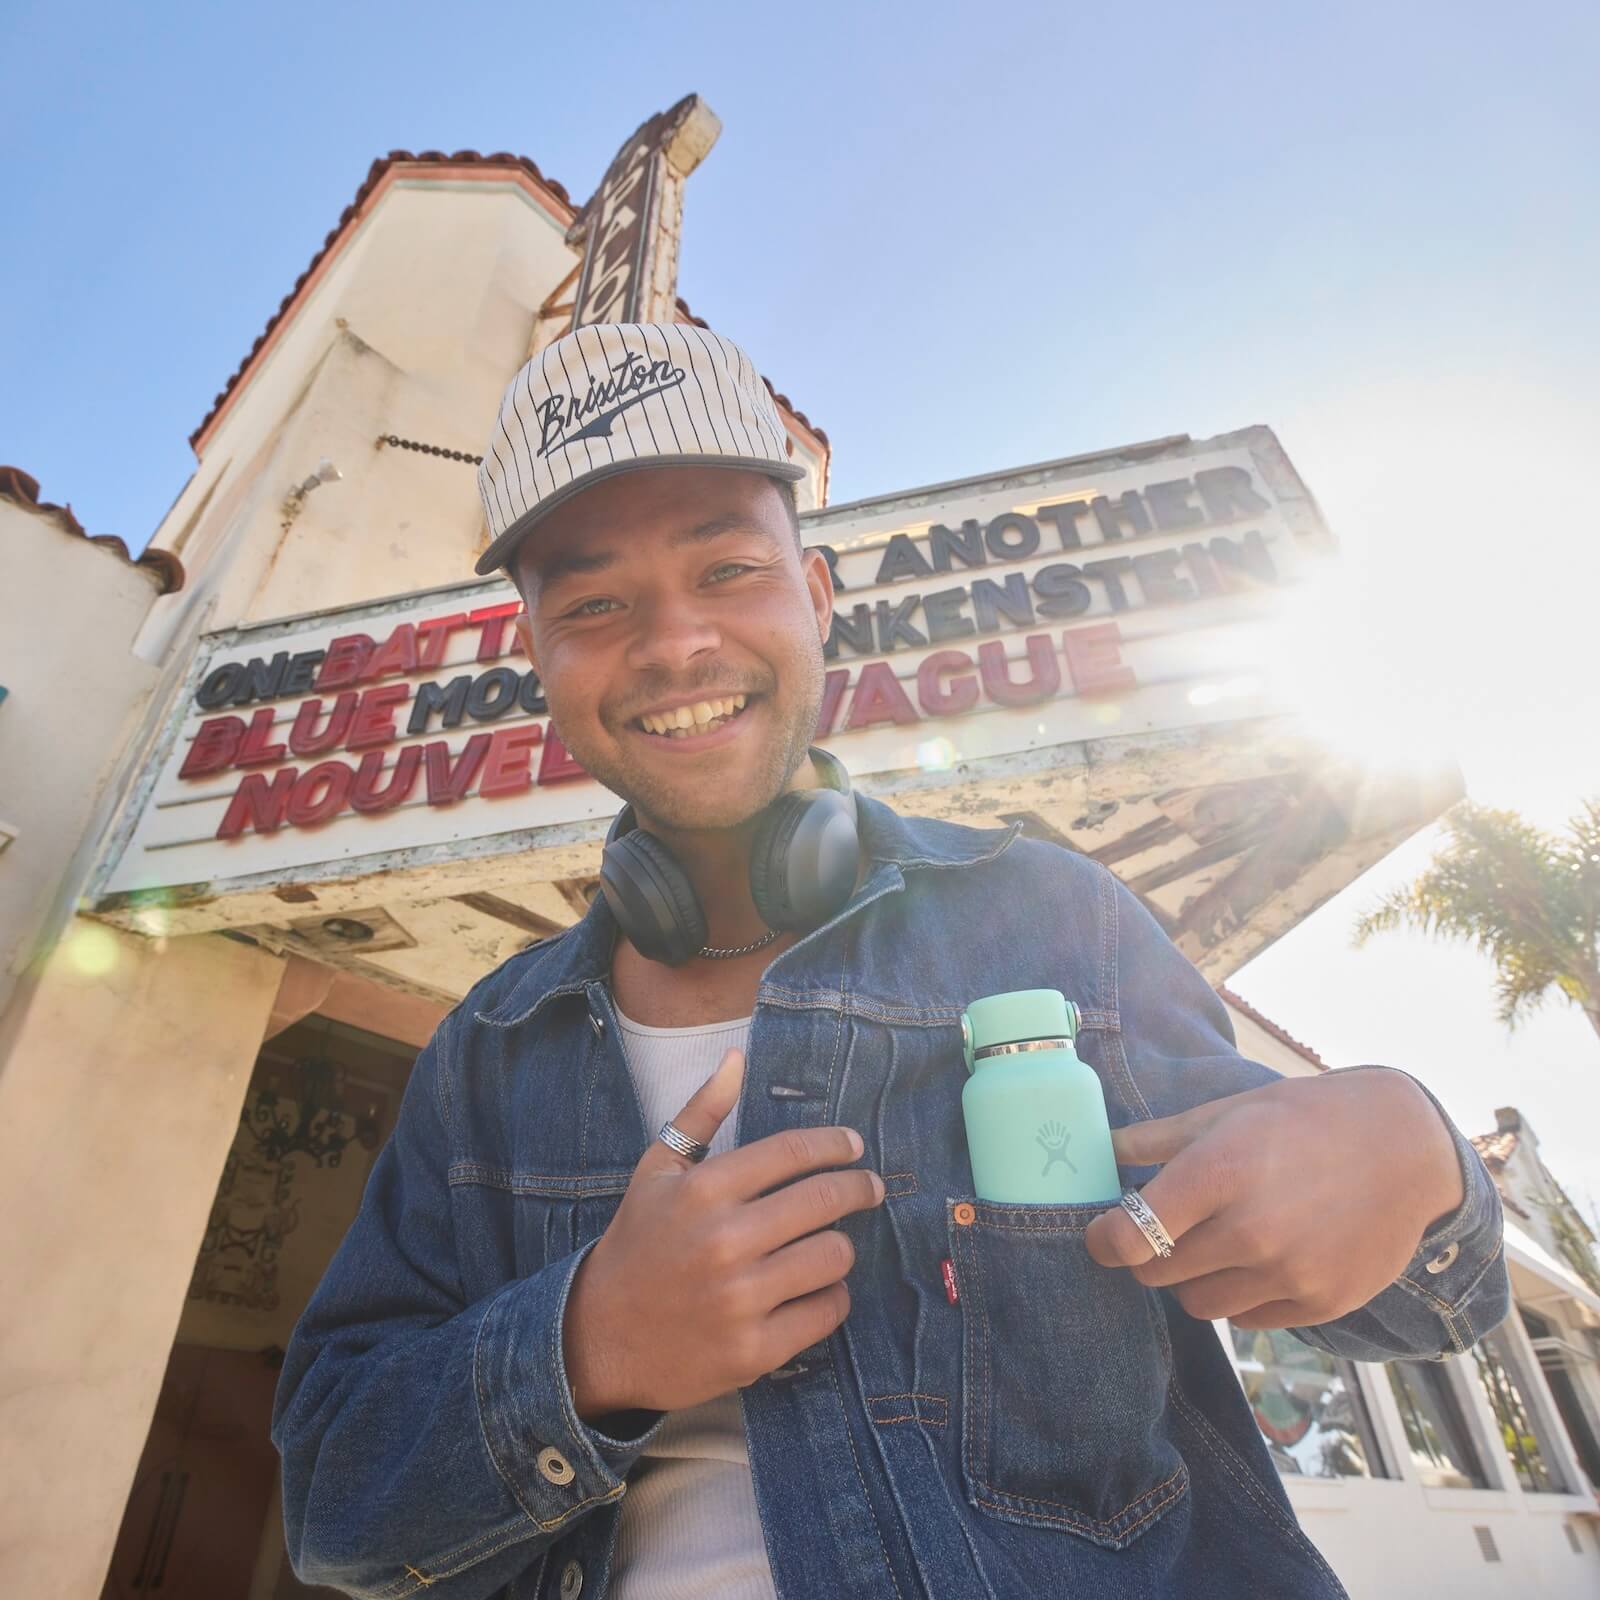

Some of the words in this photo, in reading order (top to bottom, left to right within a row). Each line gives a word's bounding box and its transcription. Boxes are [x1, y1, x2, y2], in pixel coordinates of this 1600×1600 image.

[536, 352, 686, 457] Brixton
[195, 649, 325, 711] ONE
[313, 600, 528, 692] BATT
[876, 466, 1272, 584] ANOTHER
[178, 683, 410, 780] BLUE
